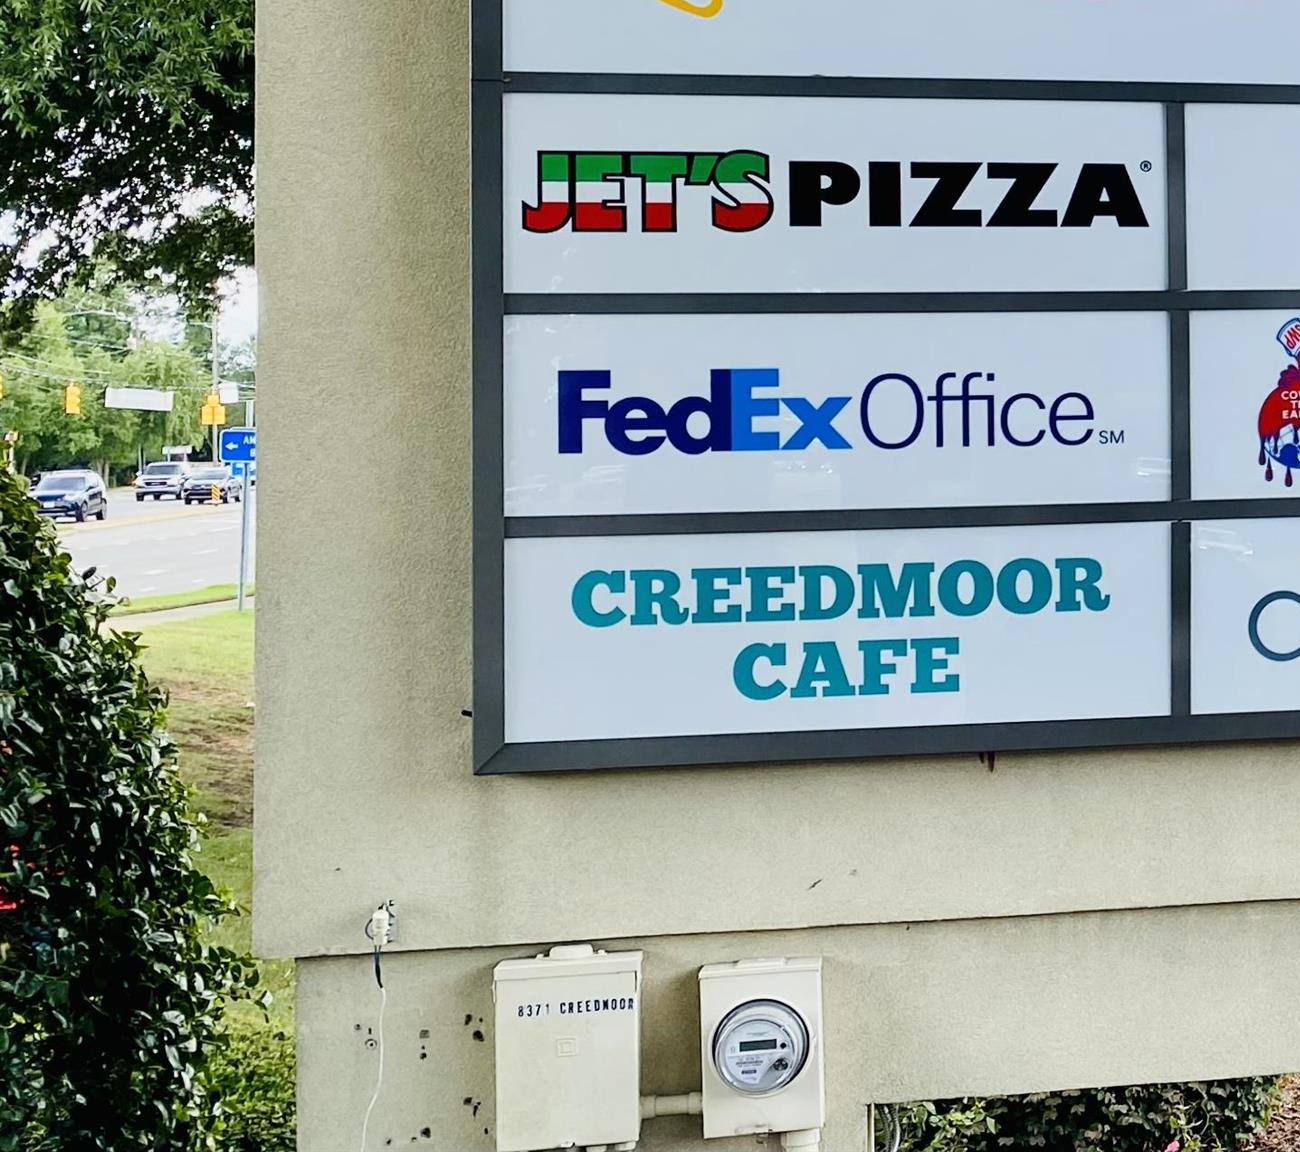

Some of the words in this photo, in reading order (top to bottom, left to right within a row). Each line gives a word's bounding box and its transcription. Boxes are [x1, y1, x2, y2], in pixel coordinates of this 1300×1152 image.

[521, 149, 775, 233] JET'S
[571, 556, 1111, 628] CREEDMOOR
[732, 636, 960, 701] CAFE
[518, 1003, 550, 1017] 8371
[560, 998, 634, 1014] CREEDMOOR
